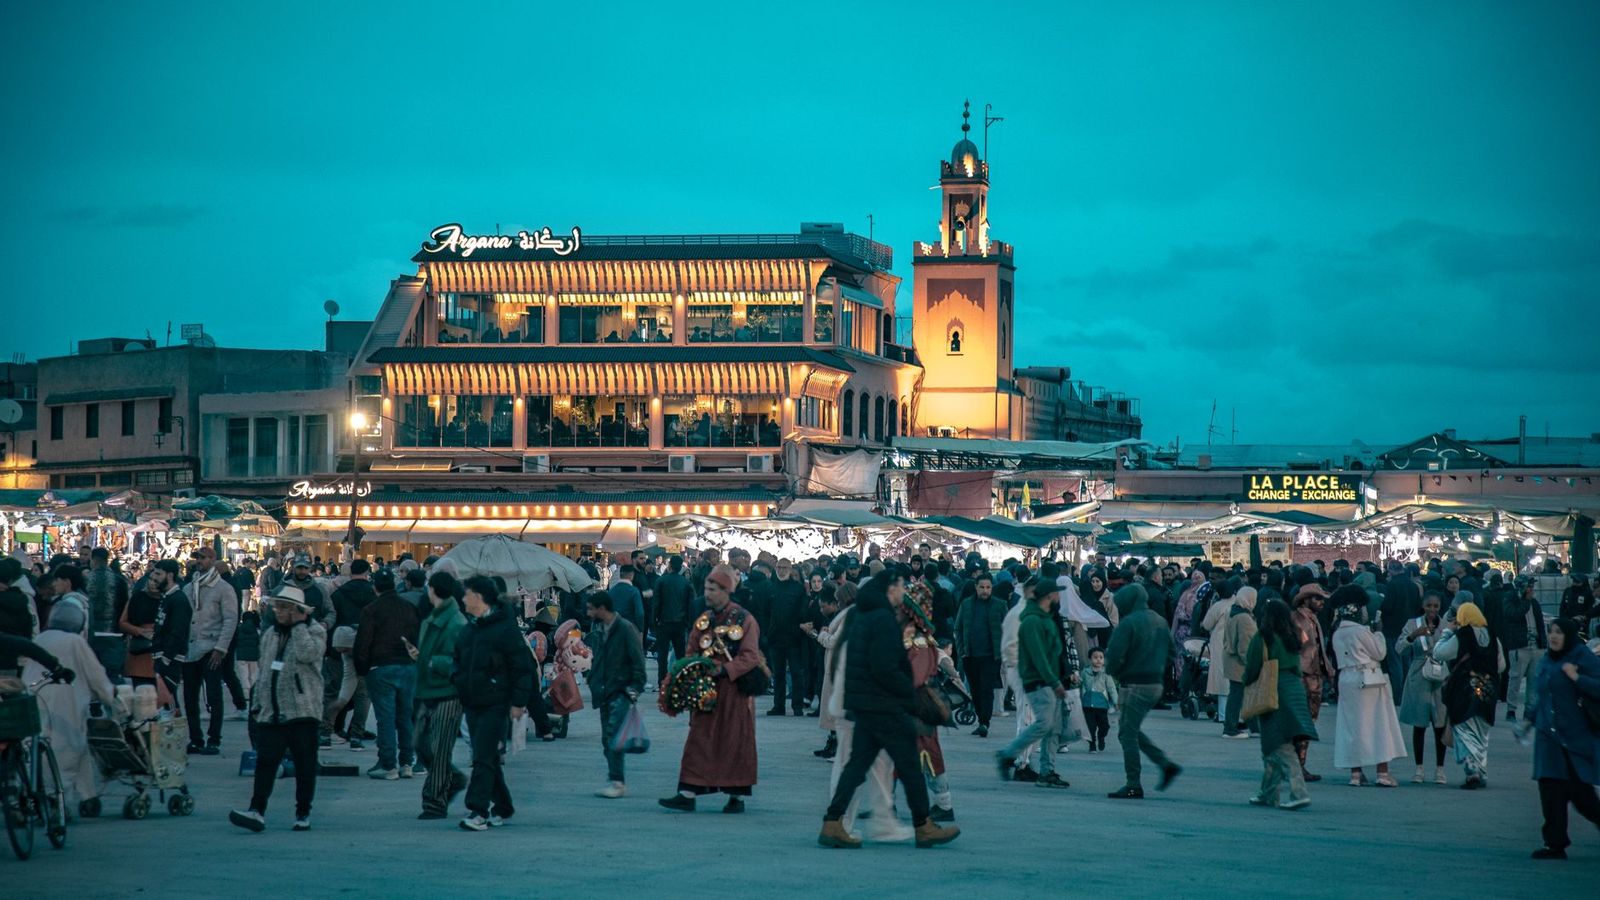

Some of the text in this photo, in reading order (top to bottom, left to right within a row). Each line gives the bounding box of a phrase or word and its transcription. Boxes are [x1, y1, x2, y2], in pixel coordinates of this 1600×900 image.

[423, 223, 513, 257] Argana
[288, 480, 337, 499] Argana
[1251, 475, 1274, 490] LA
[1282, 475, 1340, 490] PLACE
[1248, 490, 1290, 500] CHANGE
[1302, 490, 1356, 500] EXCHANGE
